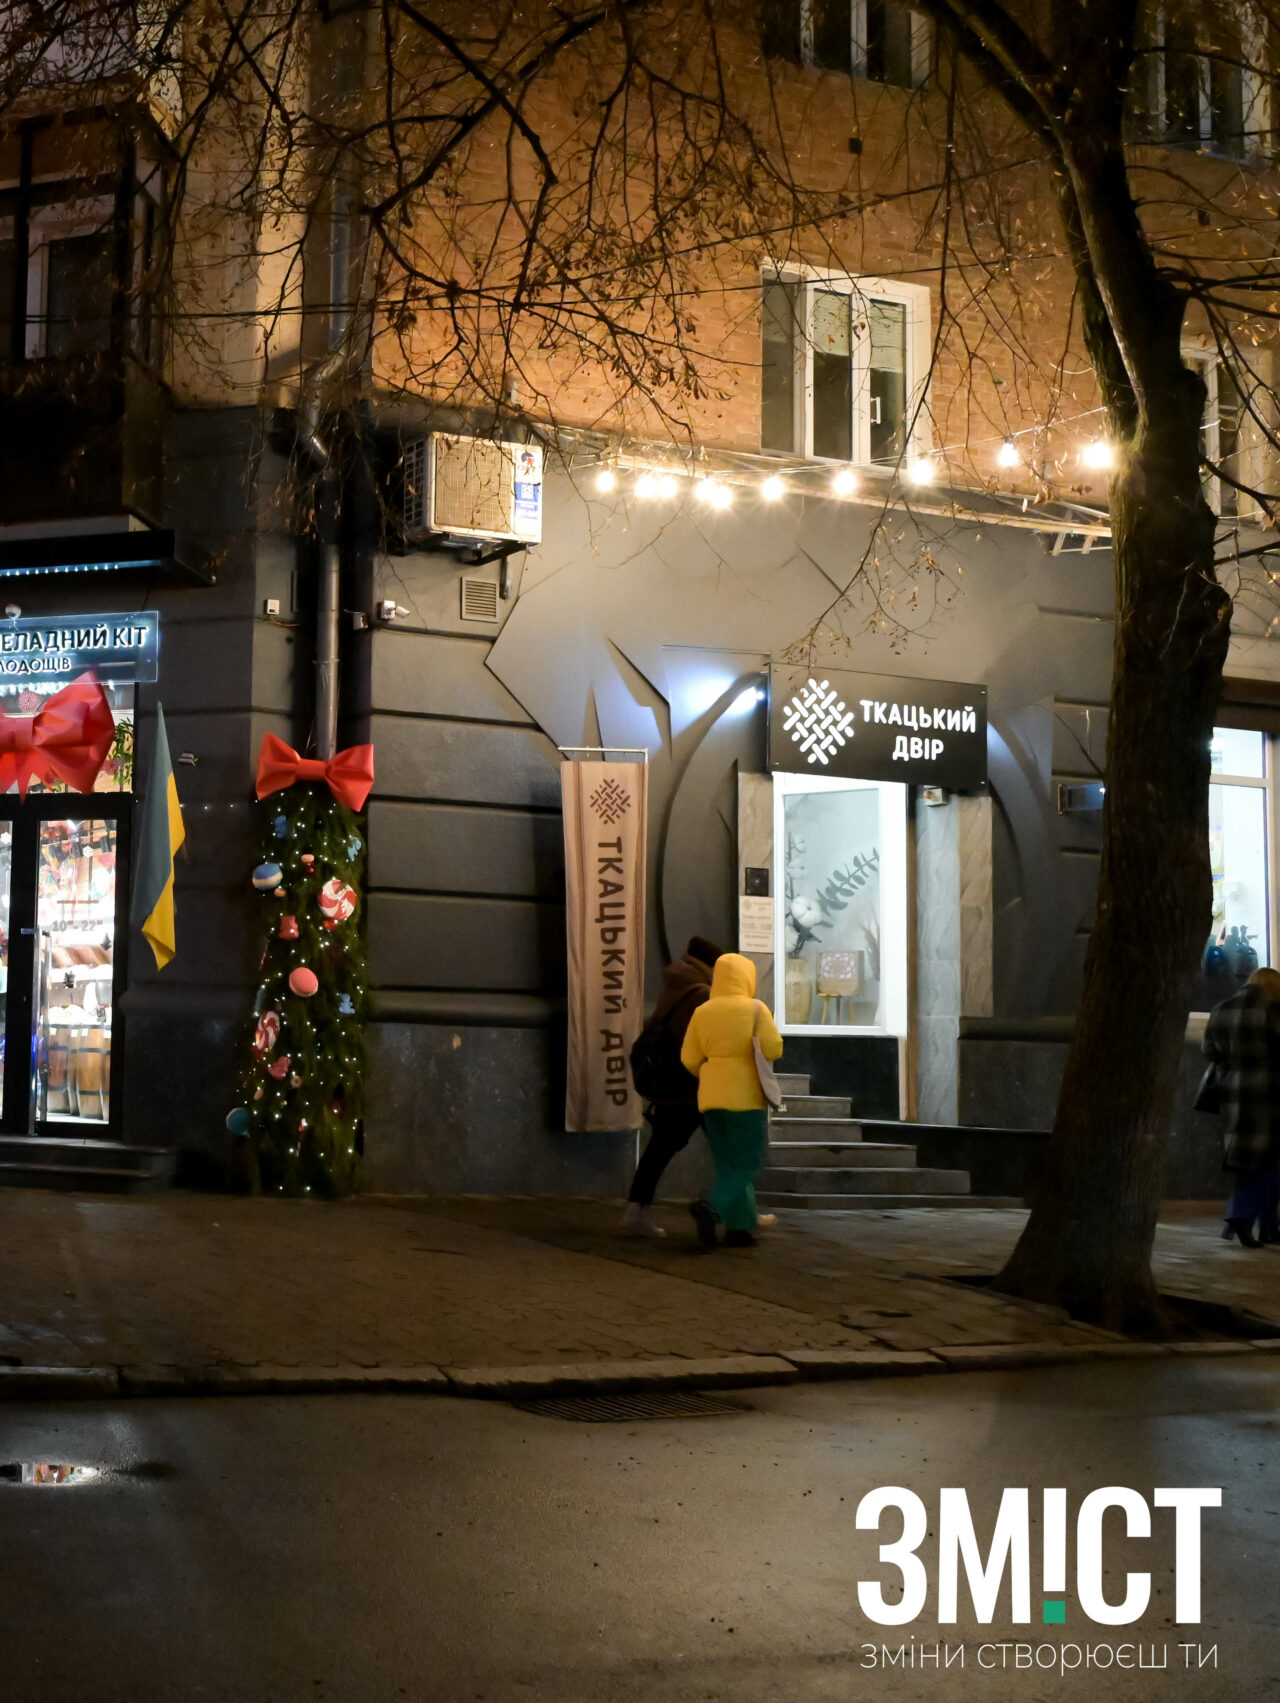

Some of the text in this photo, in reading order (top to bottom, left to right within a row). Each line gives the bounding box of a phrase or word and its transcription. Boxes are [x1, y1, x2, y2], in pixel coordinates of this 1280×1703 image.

[113, 626, 149, 649] КІТ
[859, 699, 976, 733] ТКАЦЬКИЙ
[892, 735, 944, 762] ДВІР
[594, 836, 629, 1107] ТКАЦЬКИЙ ДВІР
